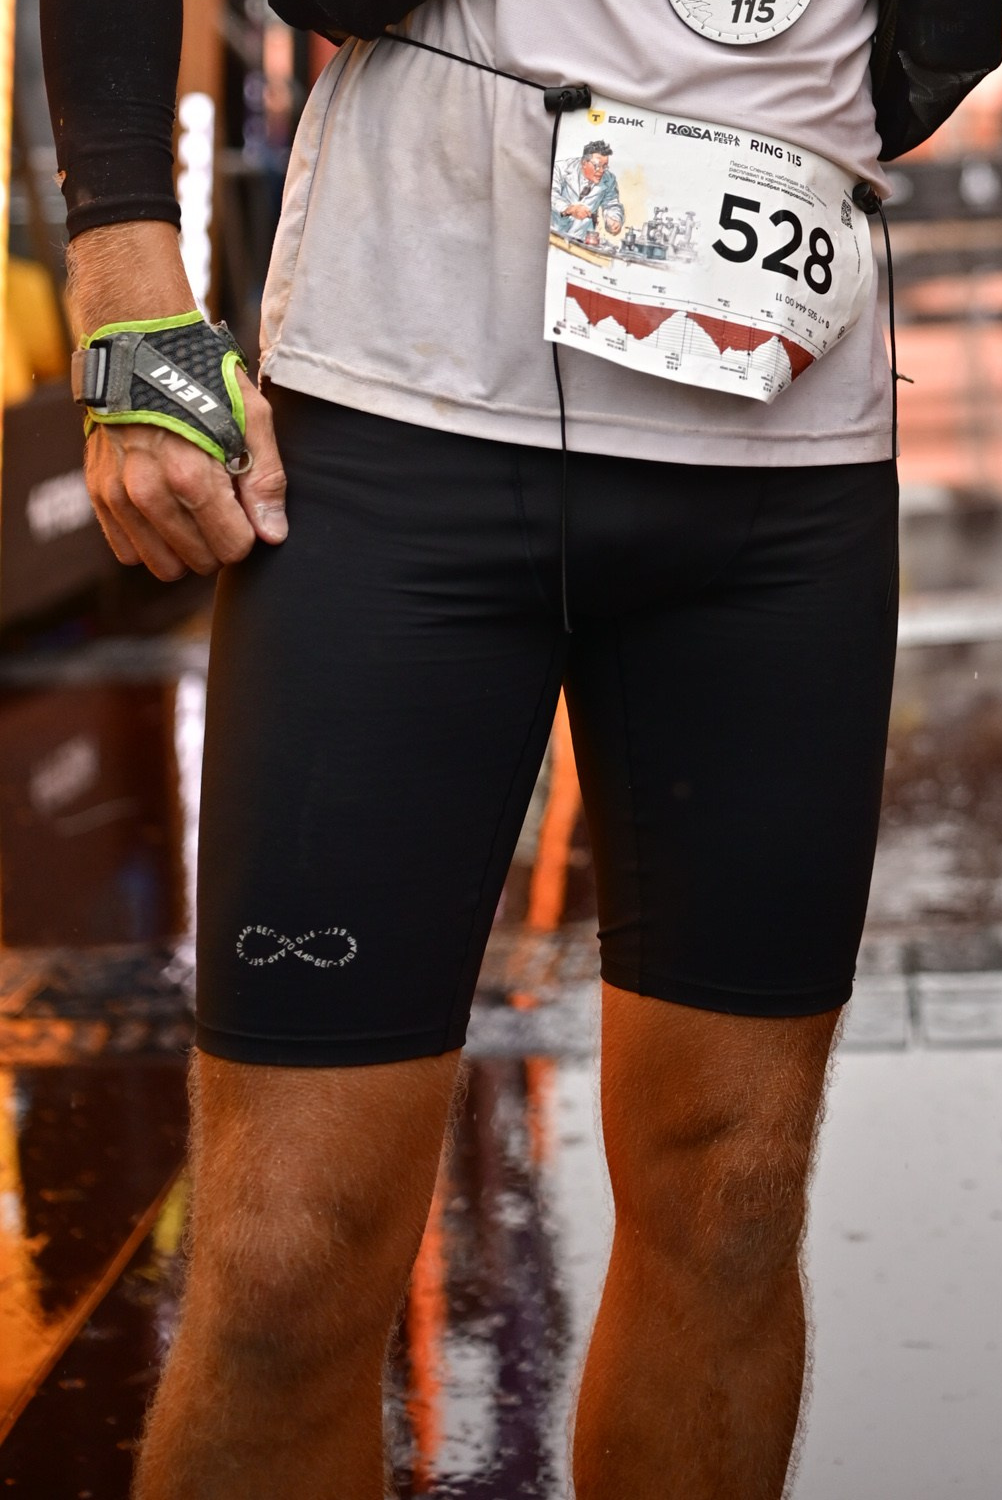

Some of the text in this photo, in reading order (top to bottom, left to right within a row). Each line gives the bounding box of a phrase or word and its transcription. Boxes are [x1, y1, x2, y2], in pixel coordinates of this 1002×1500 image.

[608, 116, 645, 128] БАНК
[666, 122, 713, 142] ROSA
[713, 131, 734, 141] WILD
[713, 137, 733, 146] FEST
[749, 139, 802, 167] RING 115
[711, 192, 835, 295] 528
[150, 365, 218, 414] LEKI
